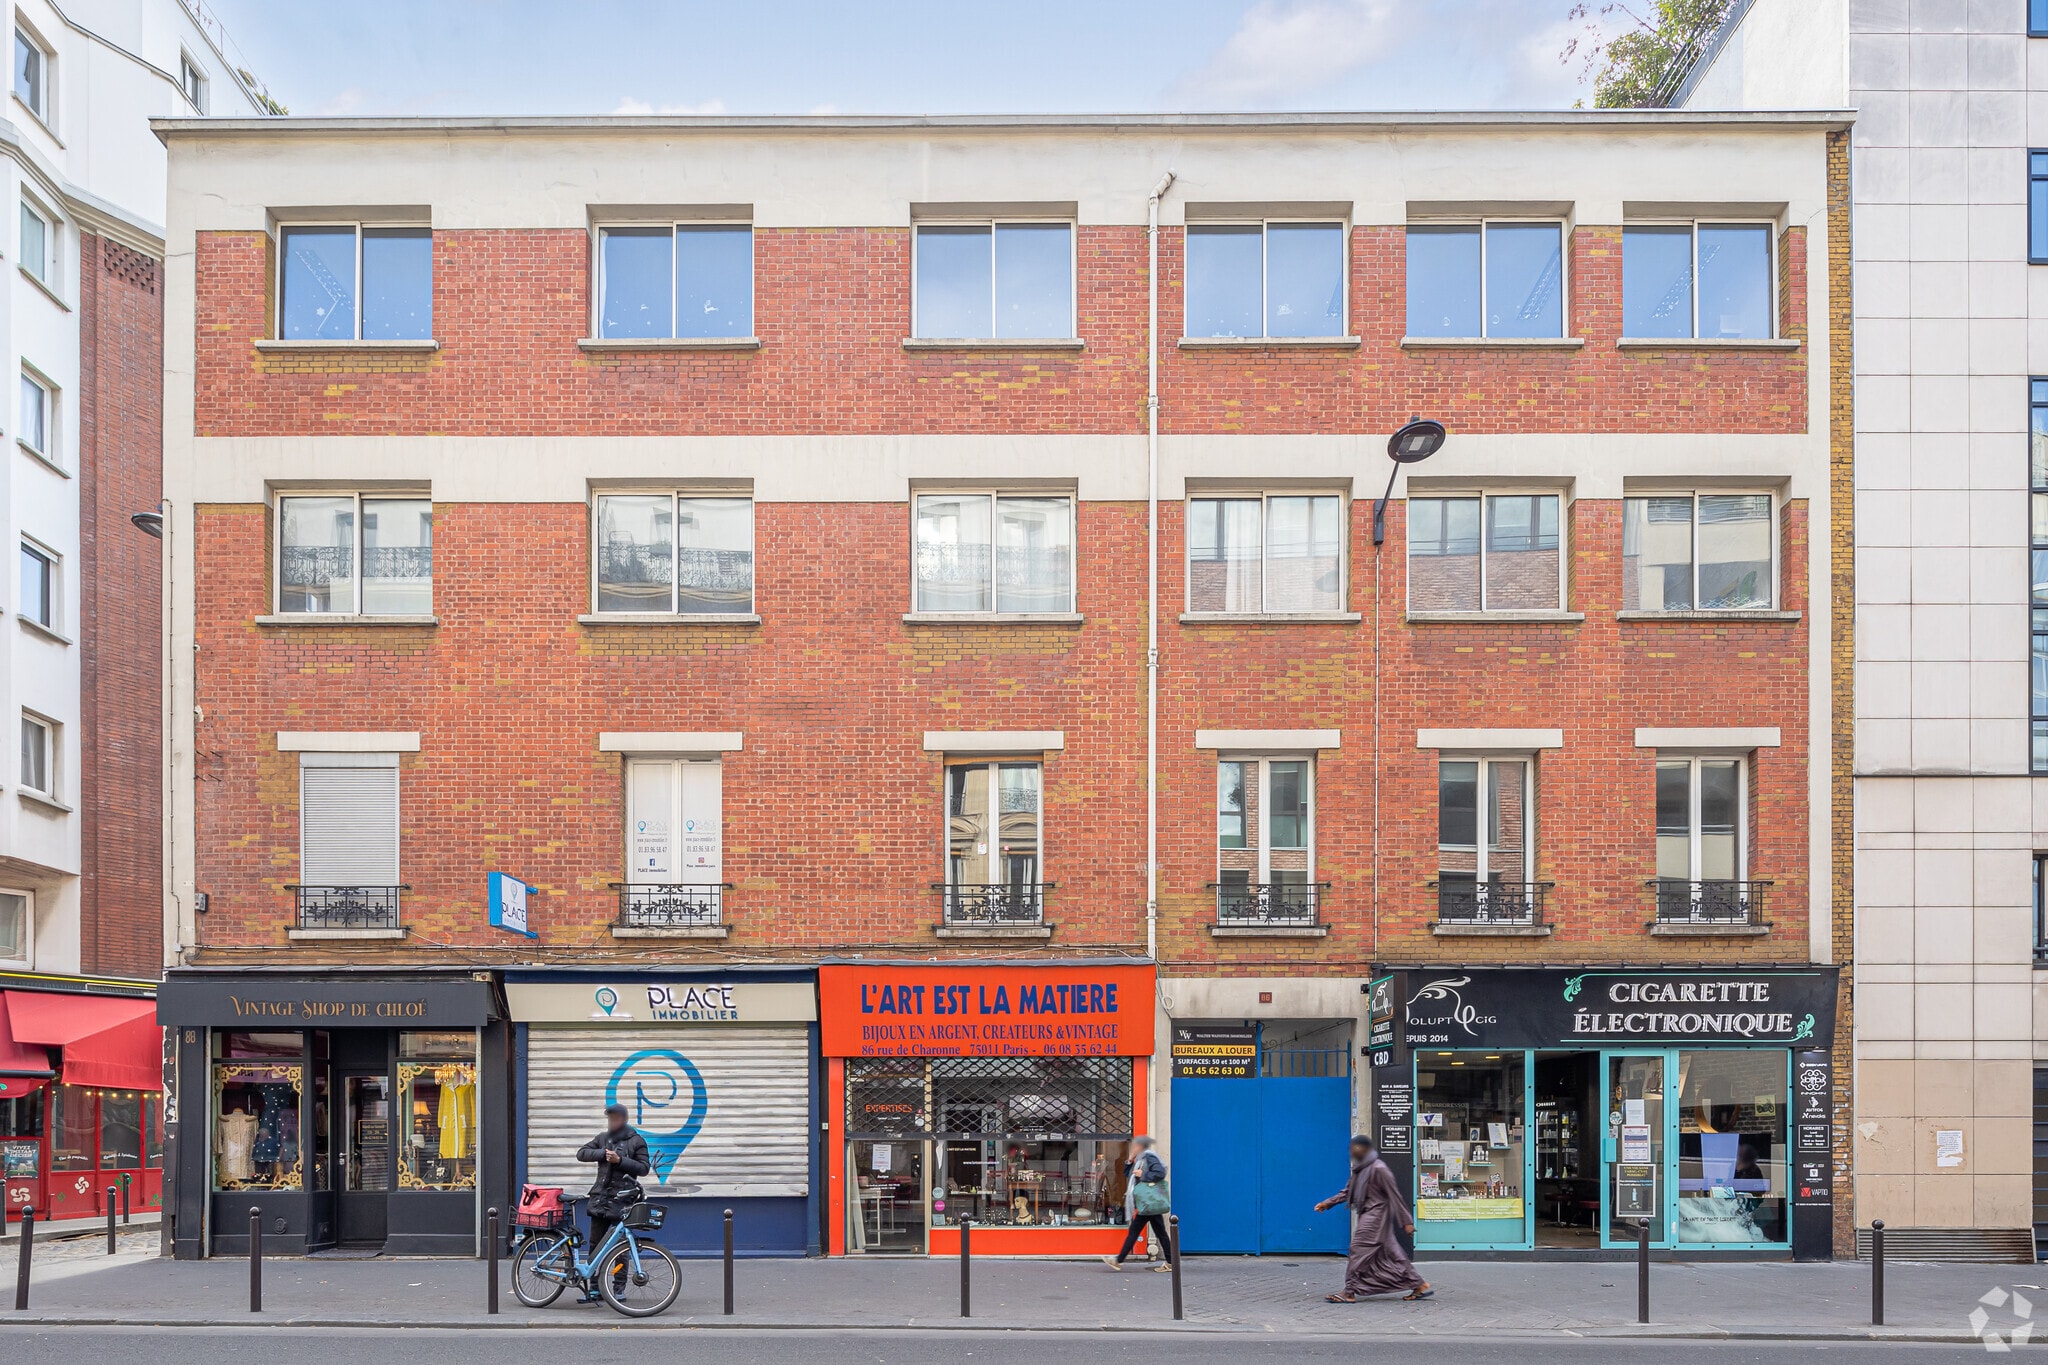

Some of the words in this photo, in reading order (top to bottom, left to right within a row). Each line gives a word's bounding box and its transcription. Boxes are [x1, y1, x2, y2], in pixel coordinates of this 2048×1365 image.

[502, 901, 526, 923] PLACE
[647, 986, 737, 1010] PLACE
[861, 984, 925, 1014] L'ART
[933, 985, 971, 1015] EST
[979, 985, 1011, 1015] LA
[1019, 983, 1119, 1014] MATIERE
[1260, 993, 1271, 1001] 86
[1609, 982, 1770, 1003] CIGARETTE
[229, 995, 297, 1017] VINTAGE
[302, 999, 346, 1020] SHOP
[351, 1002, 371, 1017] DE
[376, 998, 427, 1017] CHLOÉ
[652, 1010, 738, 1020] IMMOBILIER
[1572, 1007, 1793, 1037] ÉLECTRONIQUE
[184, 1030, 197, 1044] 88
[862, 1024, 906, 1043] BIJOUX
[909, 1025, 926, 1039] EN
[928, 1024, 980, 1041] ARGENT,
[982, 1024, 1052, 1039] CREATEURS
[1406, 1034, 1428, 1043] EPUIS
[1430, 1034, 1449, 1043] 2014
[861, 1044, 875, 1055] 86
[877, 1046, 894, 1055] rue
[896, 1044, 909, 1055] de
[911, 1044, 961, 1055] Charonne
[970, 1043, 999, 1055] 75011
[1003, 1043, 1029, 1055] Paris
[1043, 1043, 1057, 1055] 06
[1058, 1043, 1072, 1055] 08
[1089, 1043, 1102, 1055] 62
[1104, 1043, 1118, 1055] 44
[1175, 1047, 1215, 1055] BUREAUX
[1225, 1047, 1253, 1055] LOUER
[1374, 1051, 1390, 1066] CBD
[1182, 1066, 1194, 1075] 01
[1196, 1066, 1207, 1075] 45
[1208, 1066, 1220, 1075] 62
[1221, 1066, 1233, 1075] 63
[1234, 1066, 1246, 1075] 00
[1811, 1188, 1829, 1196] VAPTIO
